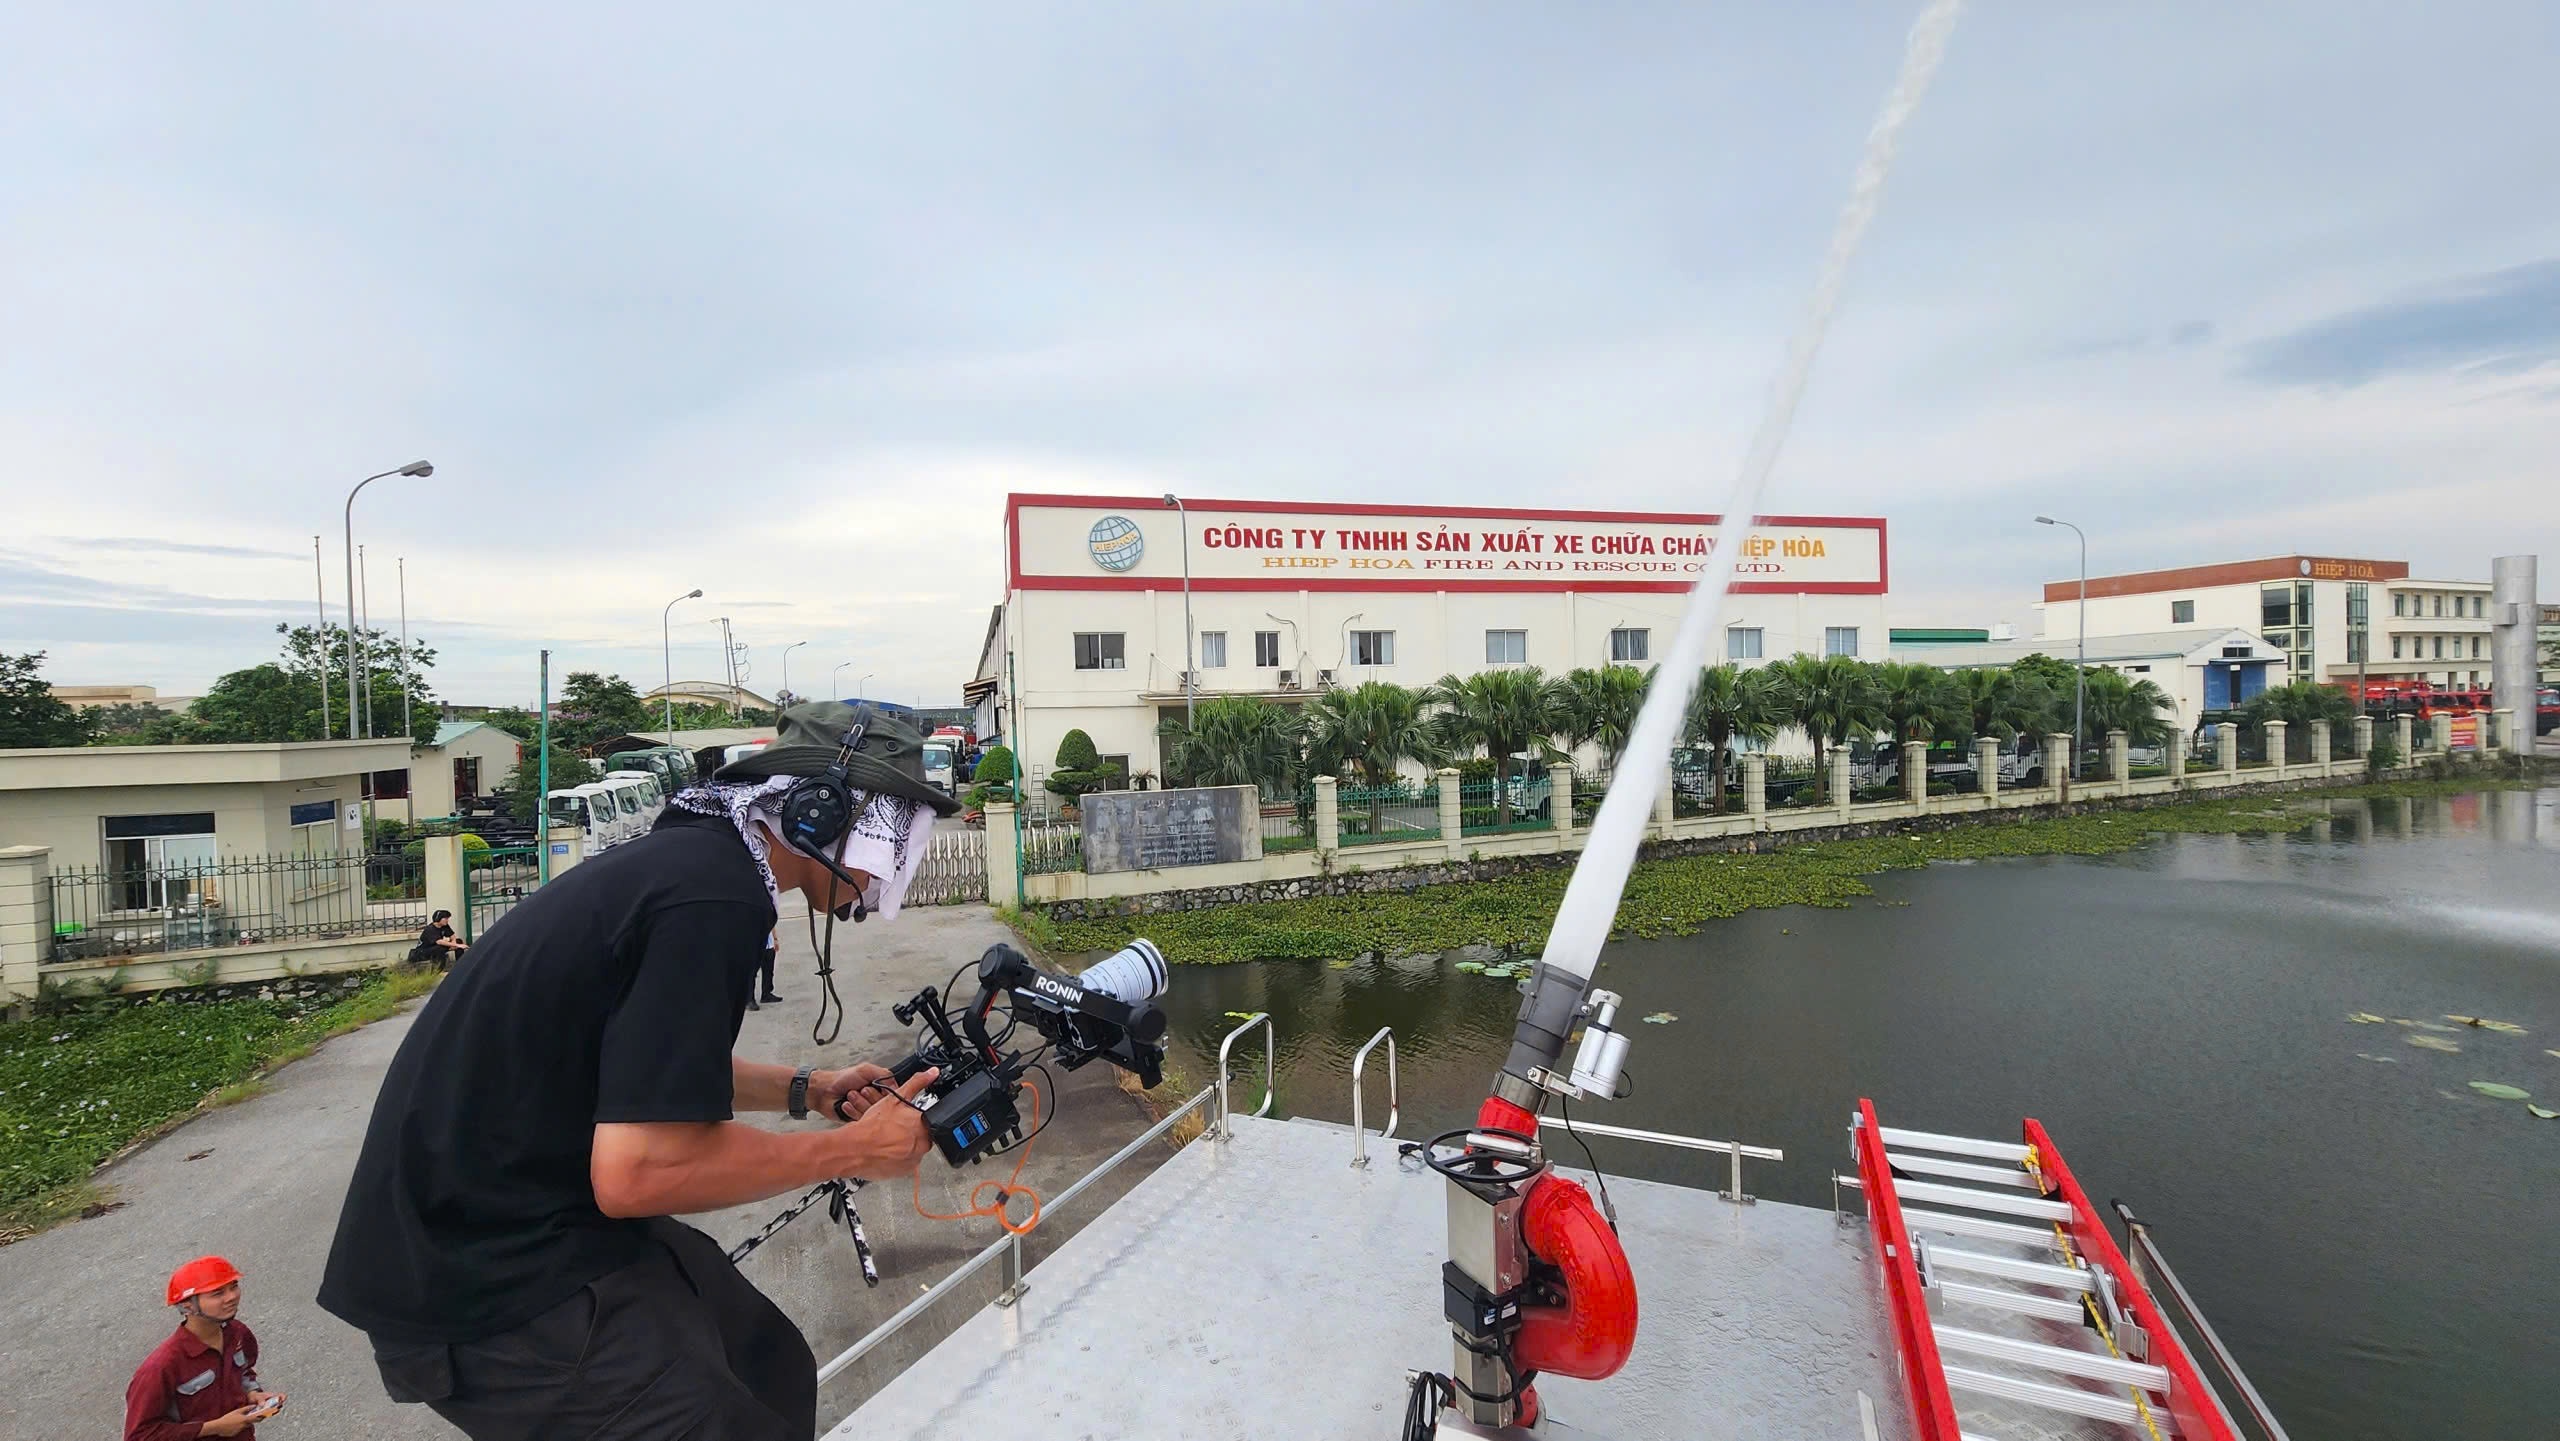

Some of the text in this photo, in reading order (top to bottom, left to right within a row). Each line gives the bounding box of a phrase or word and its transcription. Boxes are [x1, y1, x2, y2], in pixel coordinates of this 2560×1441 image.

[1203, 522, 1284, 549] CÔNG
[1291, 529, 1326, 550] TY
[1336, 530, 1408, 551] TNHH
[1416, 524, 1471, 552] SẢN
[1481, 526, 1544, 553] XUẤT
[1553, 535, 1584, 554] XE
[1591, 531, 1655, 555] CHỮA
[1739, 534, 1776, 560] IỆP
[1782, 535, 1826, 558] HÒA
[1262, 557, 1338, 569] HIEP
[1349, 558, 1415, 570] HOA
[1424, 559, 1493, 570] FIRE
[1503, 559, 1564, 571] AND
[1573, 561, 1677, 573] RESCUE
[1035, 975, 1084, 1004] RONIN
